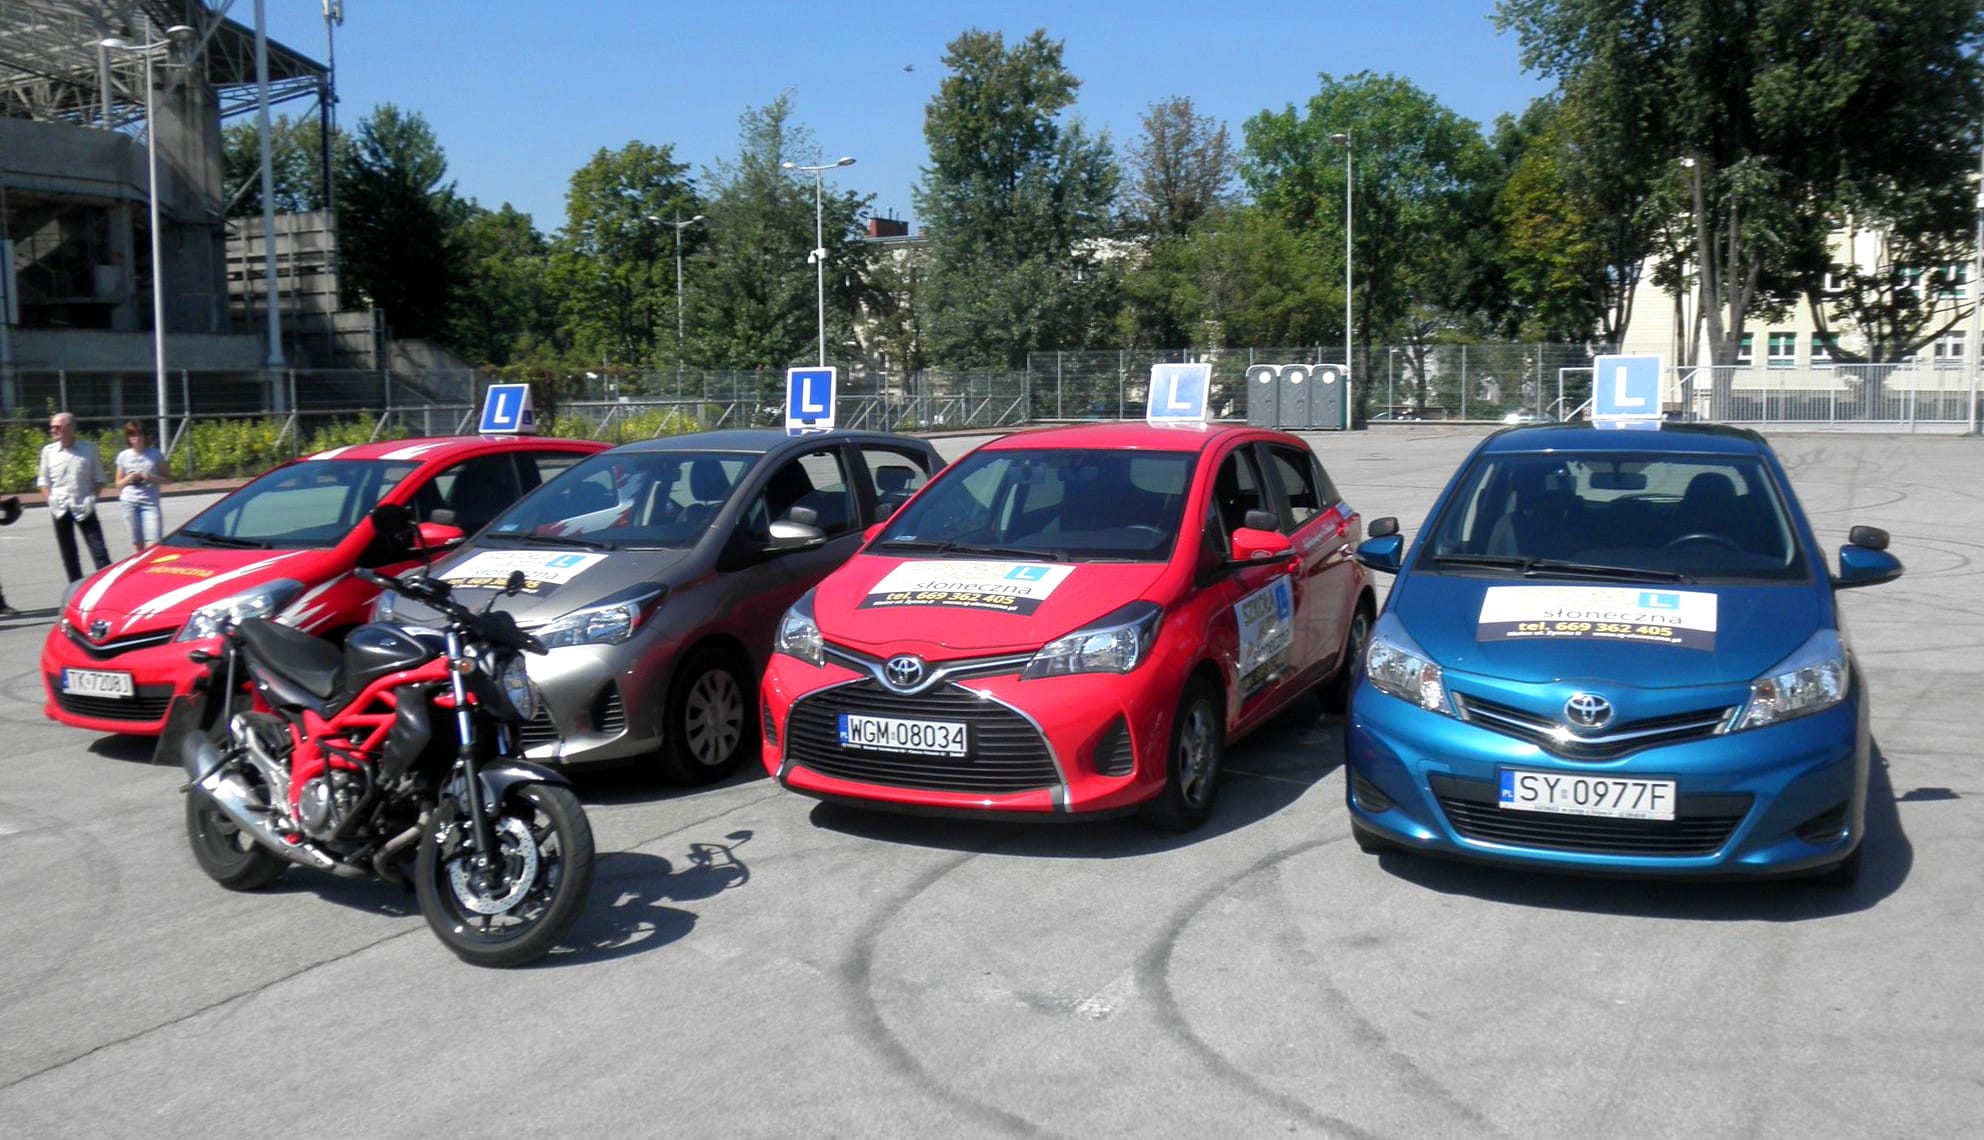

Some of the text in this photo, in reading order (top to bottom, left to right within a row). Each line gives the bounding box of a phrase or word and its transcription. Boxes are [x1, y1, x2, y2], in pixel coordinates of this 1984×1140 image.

[802, 378, 824, 413] L
[1168, 374, 1193, 410] L
[1615, 366, 1646, 407] L
[493, 393, 511, 424] L
[556, 556, 570, 567] L
[1017, 566, 1035, 580] L
[913, 580, 1033, 596] słoneczna
[885, 591, 1016, 606] tel. 669 362 405
[1649, 593, 1674, 608] L
[1543, 607, 1683, 626] słoneczna
[1518, 621, 1551, 633] tel.
[1554, 621, 1593, 633] 669
[1595, 622, 1633, 635] 362
[1635, 624, 1674, 638] 405
[850, 718, 889, 745] WGM
[896, 722, 965, 751] 08034
[1519, 775, 1670, 811] SY 0977F
